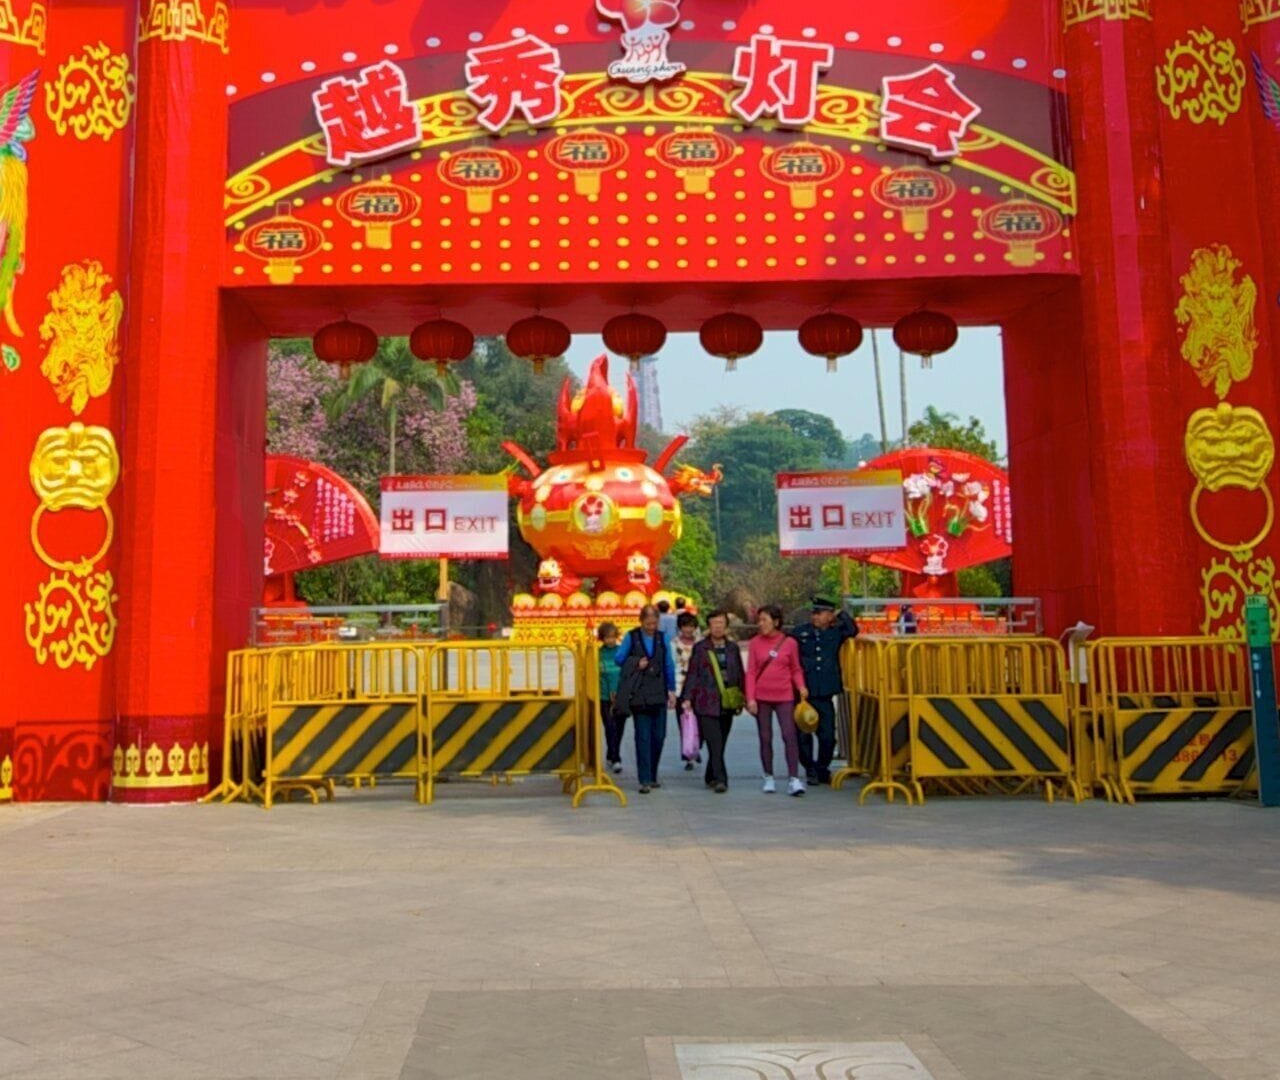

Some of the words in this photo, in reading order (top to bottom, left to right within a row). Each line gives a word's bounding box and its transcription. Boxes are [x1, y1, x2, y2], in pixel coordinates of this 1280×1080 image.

[312, 34, 981, 165] 越秀灯会
[558, 140, 608, 162] 福
[670, 140, 717, 160] 福
[450, 159, 502, 180] 福
[774, 154, 824, 175] 福
[886, 178, 935, 199] 福
[350, 194, 401, 215] 福
[996, 210, 1046, 232] 福
[255, 230, 305, 251] 福
[392, 508, 447, 531] 出口
[454, 516, 498, 531] EXIT
[789, 505, 844, 528] 出口
[852, 511, 896, 526] EXIT
